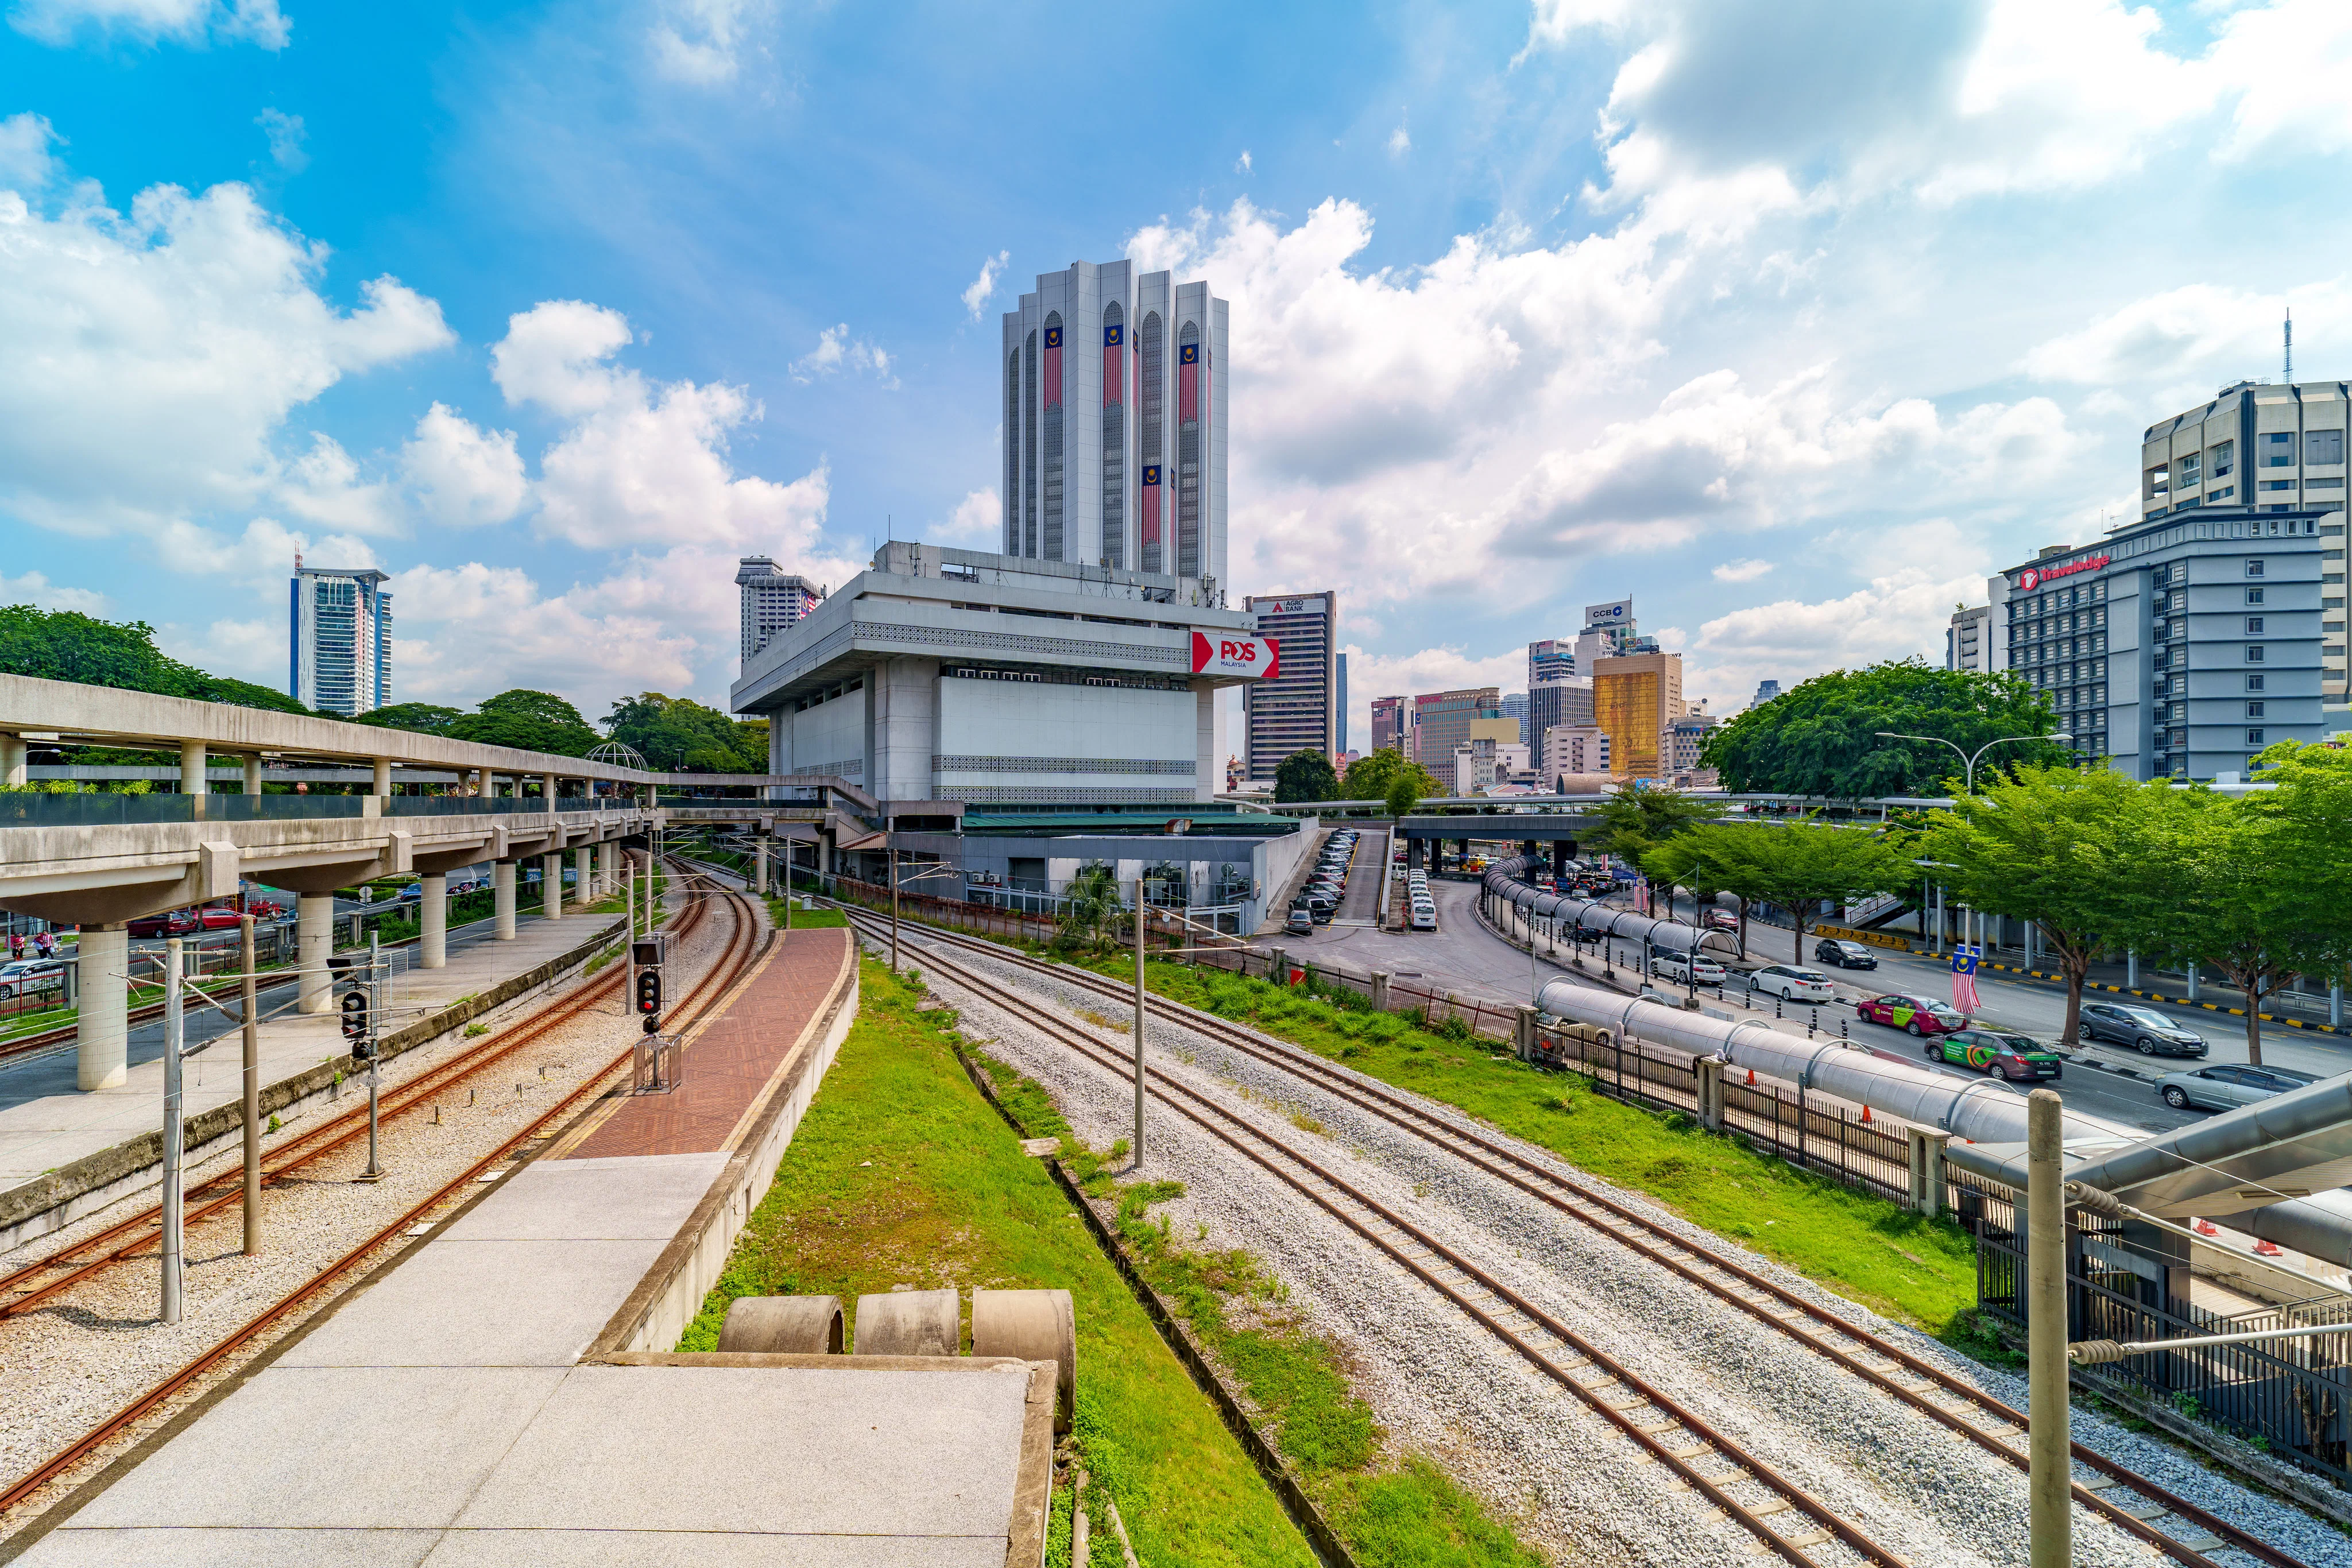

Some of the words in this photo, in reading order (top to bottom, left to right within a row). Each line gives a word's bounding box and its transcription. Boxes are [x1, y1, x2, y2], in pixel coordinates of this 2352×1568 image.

[2040, 555, 2110, 582] Travelodge
[1221, 640, 1256, 661] POS
[1425, 695, 1442, 703] OCBC
